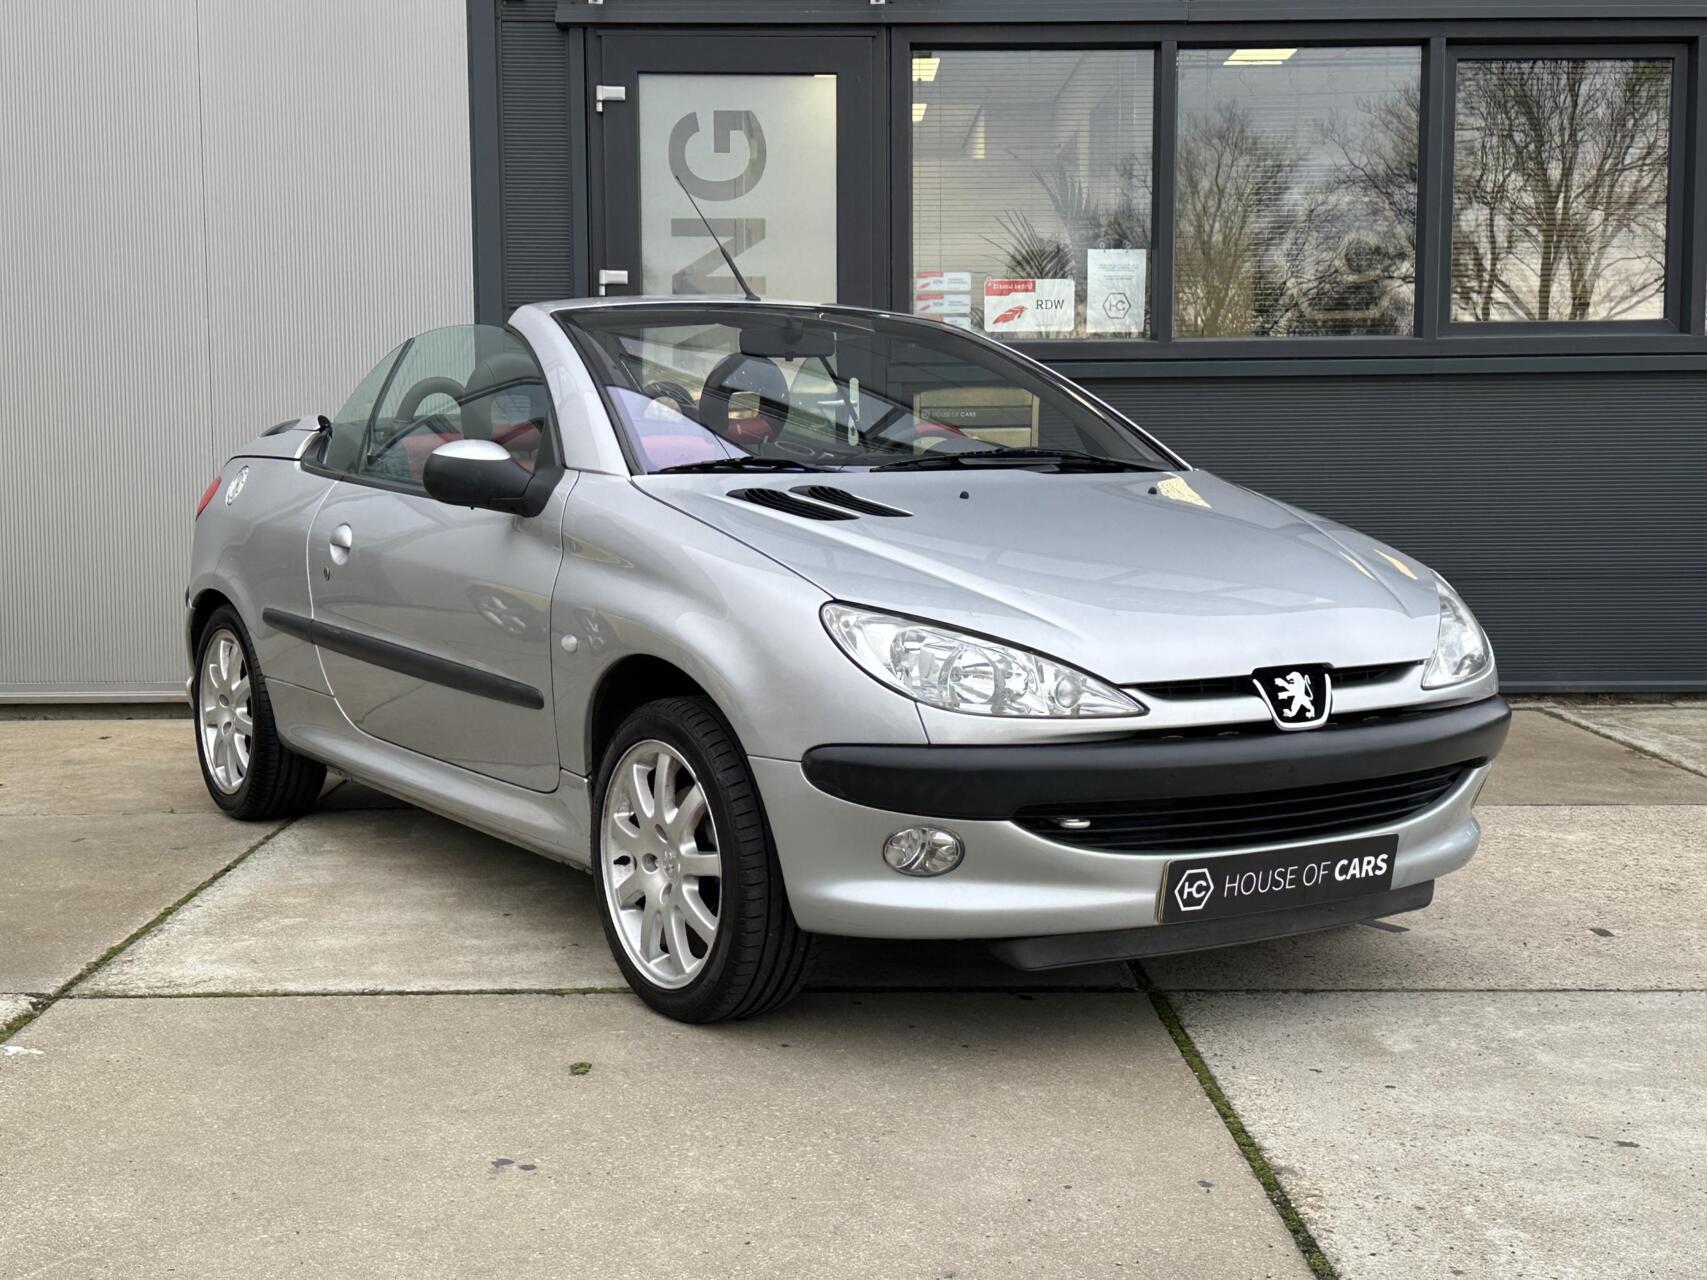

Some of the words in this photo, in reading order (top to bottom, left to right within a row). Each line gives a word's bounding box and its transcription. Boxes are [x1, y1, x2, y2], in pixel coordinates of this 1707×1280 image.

[1036, 299, 1065, 310] RDW
[1224, 866, 1299, 898] HOUSE
[1302, 861, 1332, 887] OF
[1334, 853, 1389, 882] CARS
